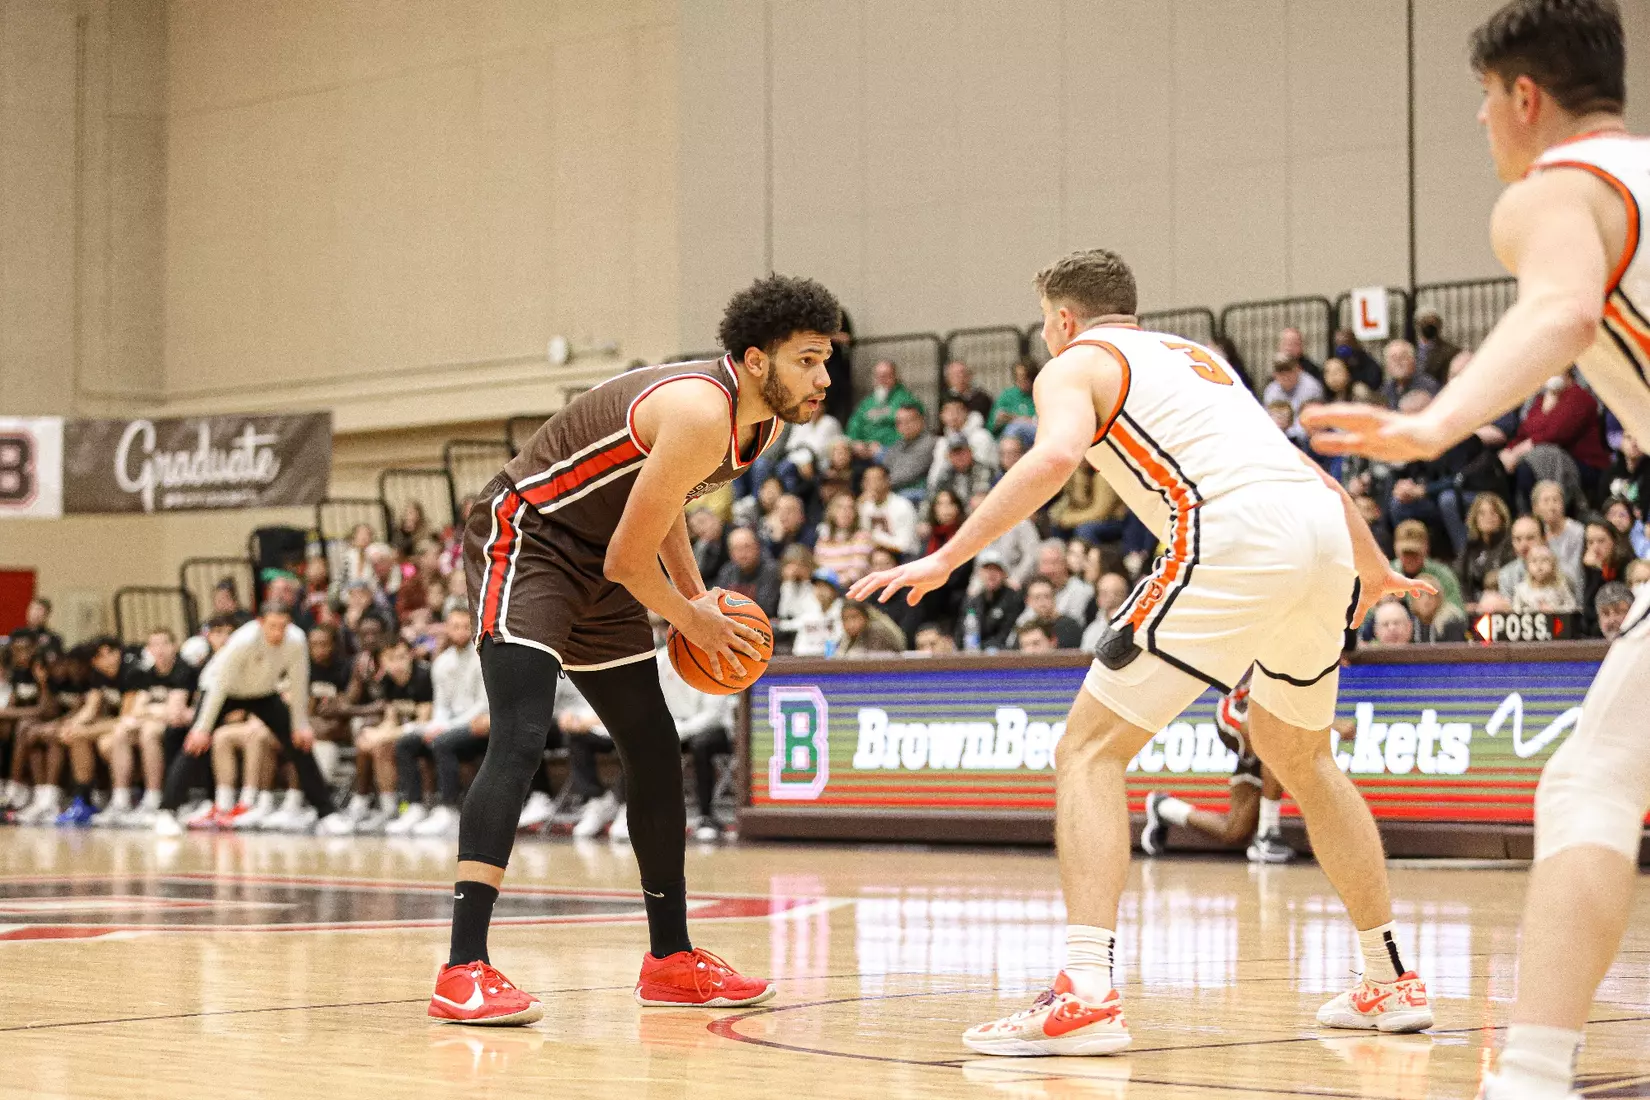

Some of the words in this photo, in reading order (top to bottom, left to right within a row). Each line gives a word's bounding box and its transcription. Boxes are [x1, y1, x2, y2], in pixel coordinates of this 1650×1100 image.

[1361, 298, 1380, 329] L
[1160, 340, 1234, 386] 3
[114, 420, 281, 513] Graduate
[769, 685, 829, 800] B
